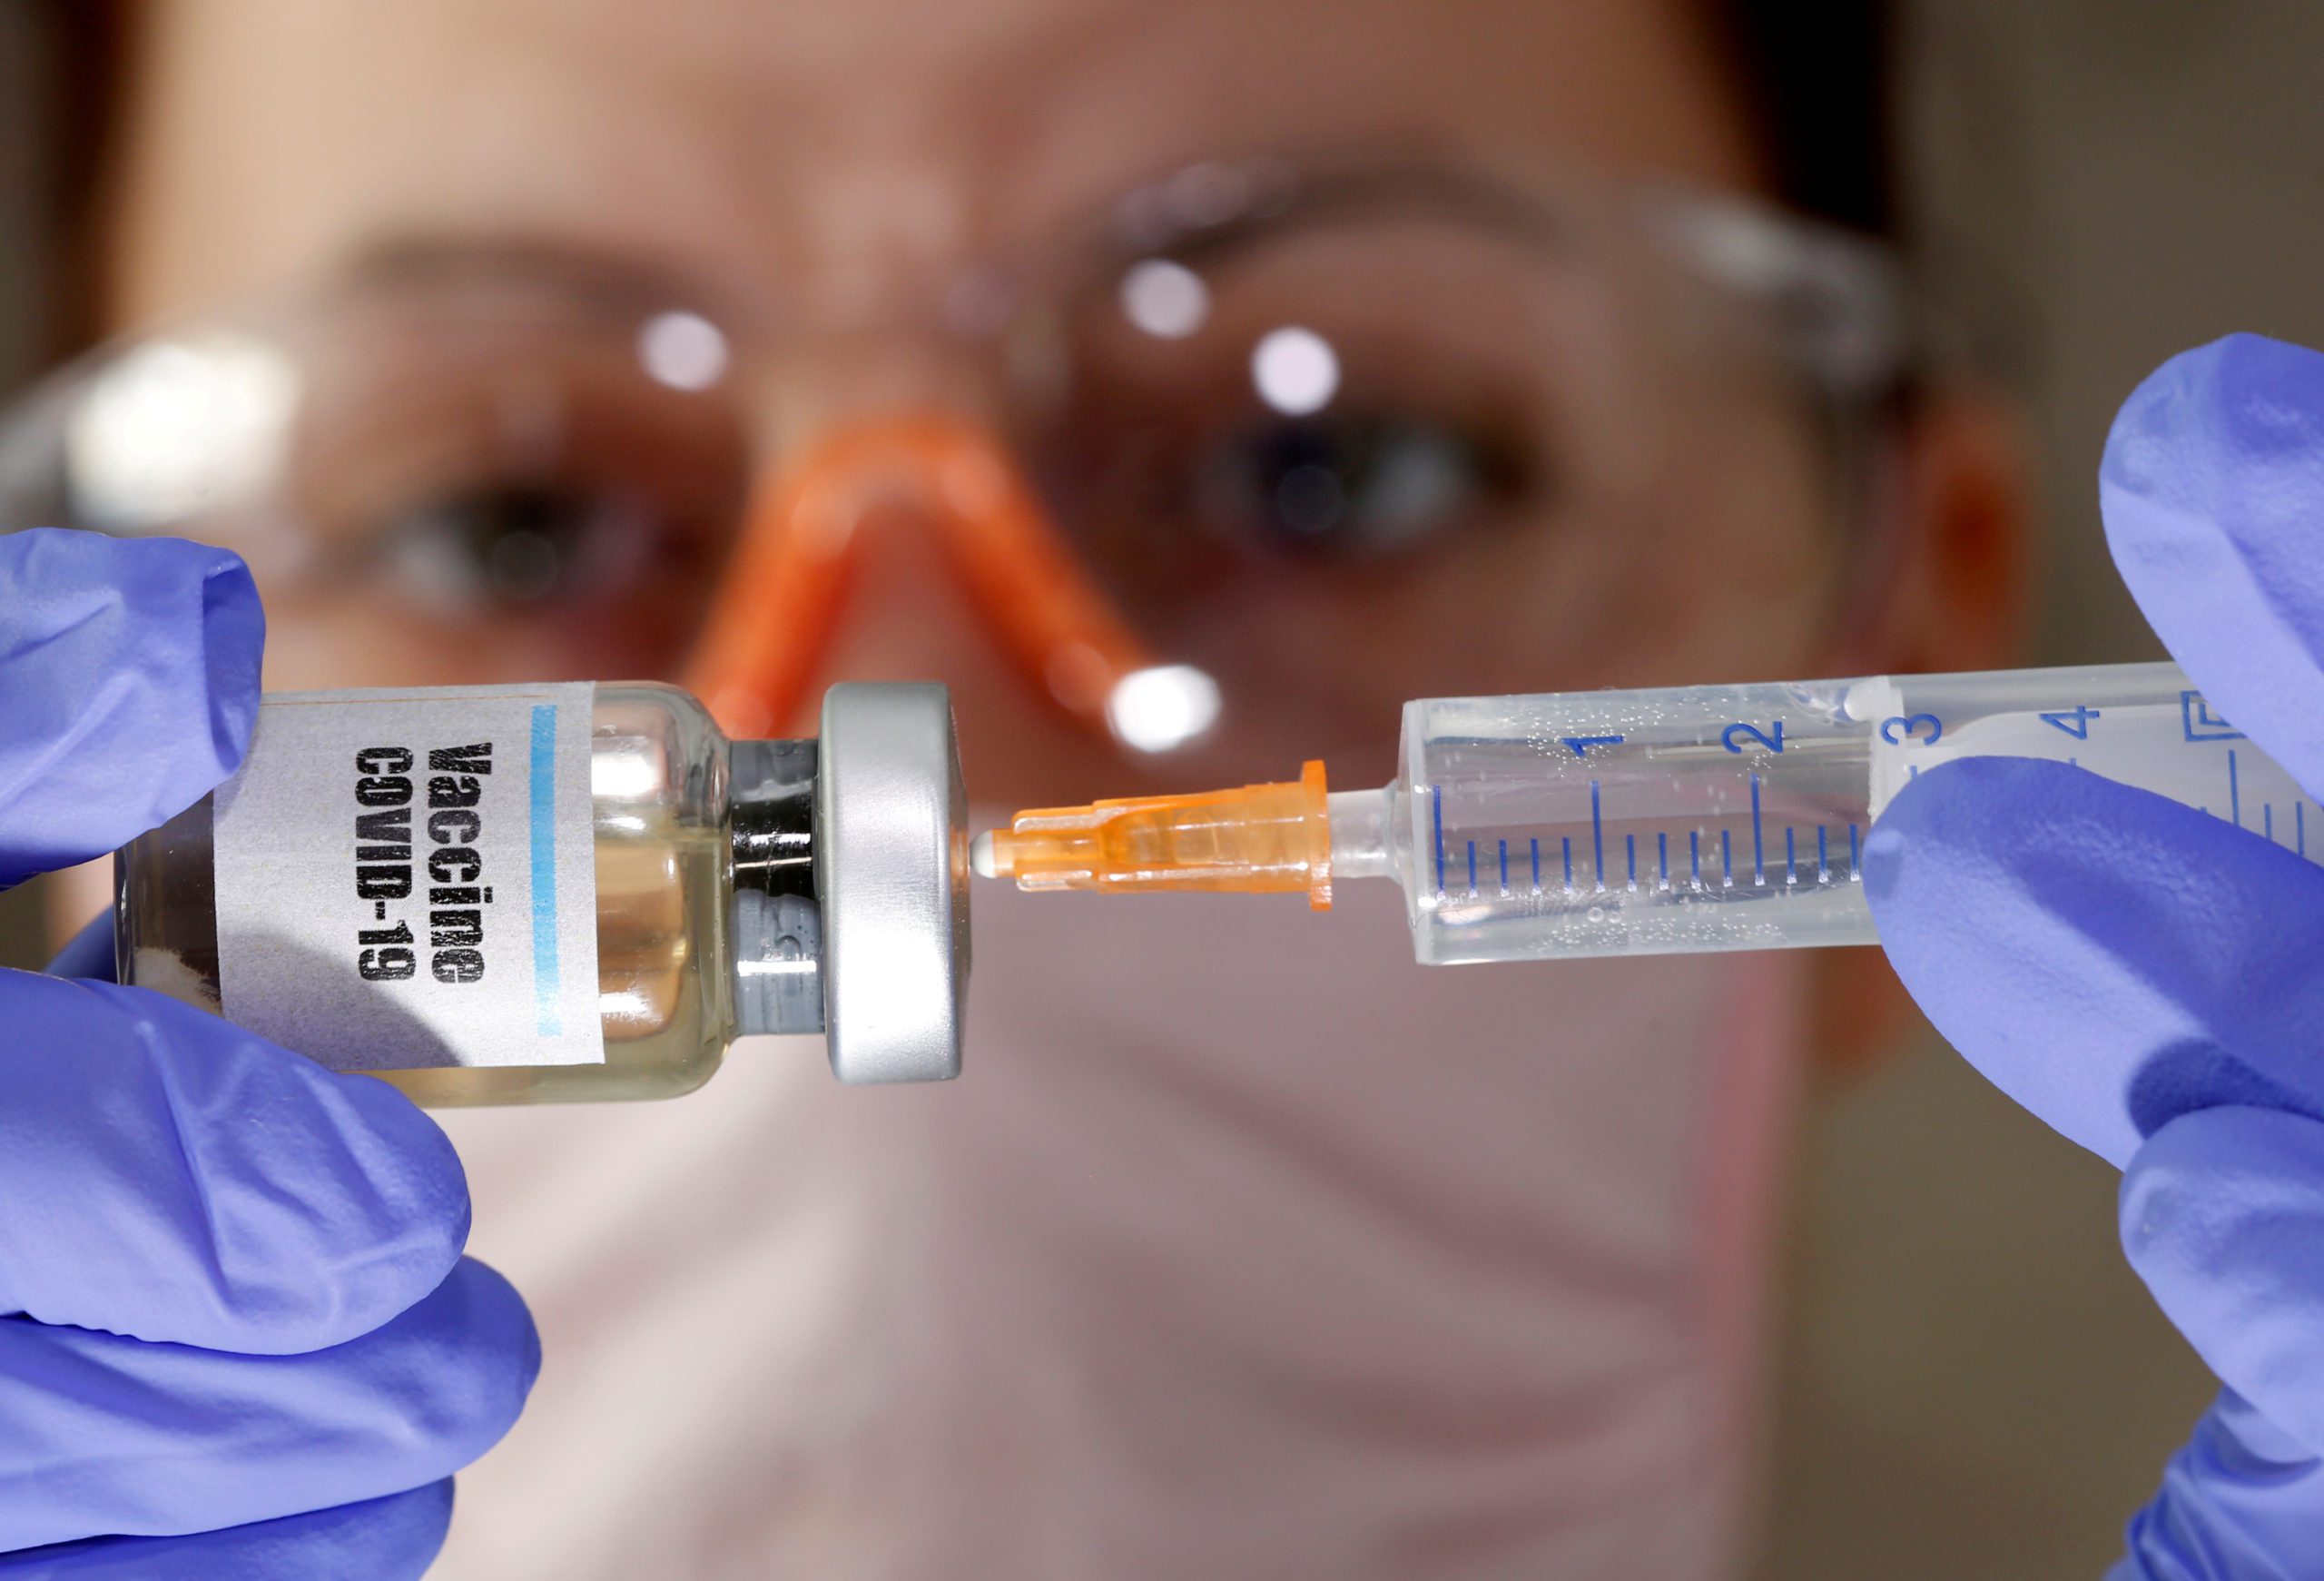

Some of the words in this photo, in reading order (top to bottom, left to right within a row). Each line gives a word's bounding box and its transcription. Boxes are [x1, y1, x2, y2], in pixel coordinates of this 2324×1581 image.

[1721, 721, 1784, 755] 2
[1880, 713, 1942, 746] 3
[2038, 705, 2100, 740] 4
[1561, 736, 1624, 757] 1
[355, 746, 417, 982] COVID-19
[428, 742, 494, 983] Vaccine
